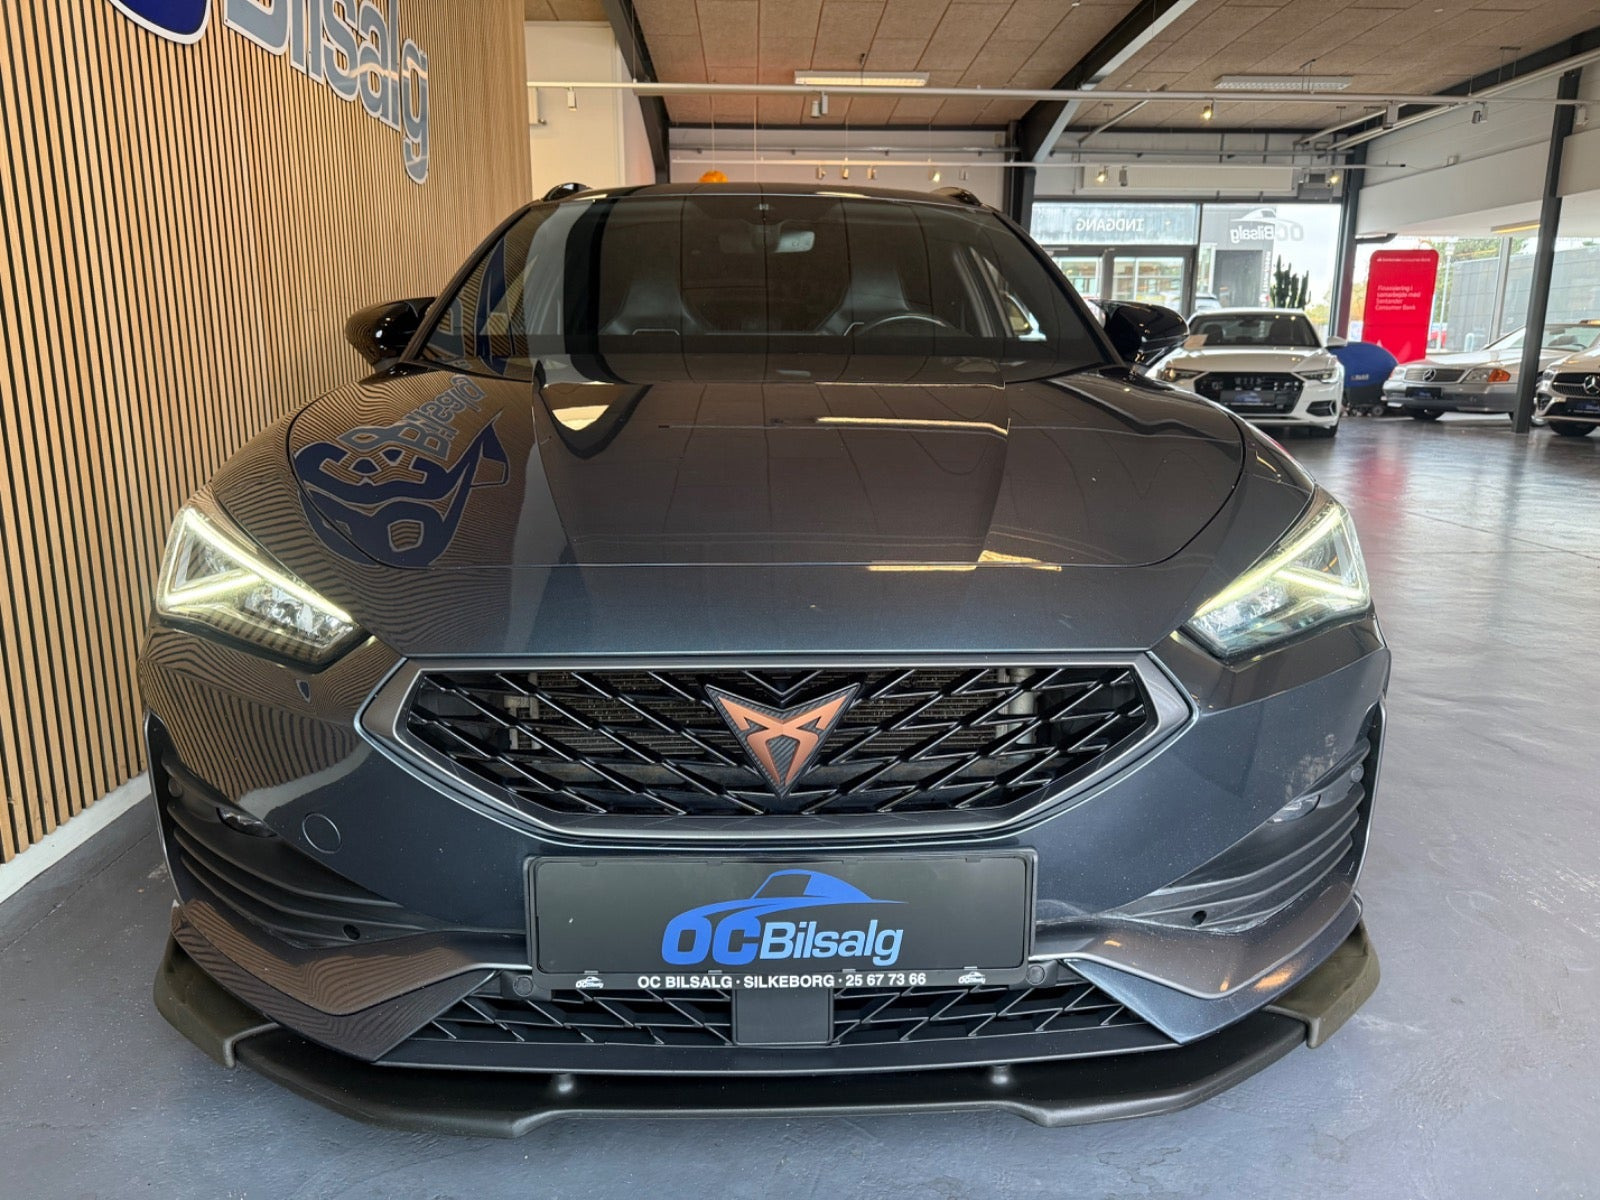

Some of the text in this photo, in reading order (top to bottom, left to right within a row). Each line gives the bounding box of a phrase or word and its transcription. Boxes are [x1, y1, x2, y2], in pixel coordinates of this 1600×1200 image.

[223, 0, 430, 185] salg
[637, 971, 927, 989] OC BILSALG SILKEBORG 25 67 73 66
